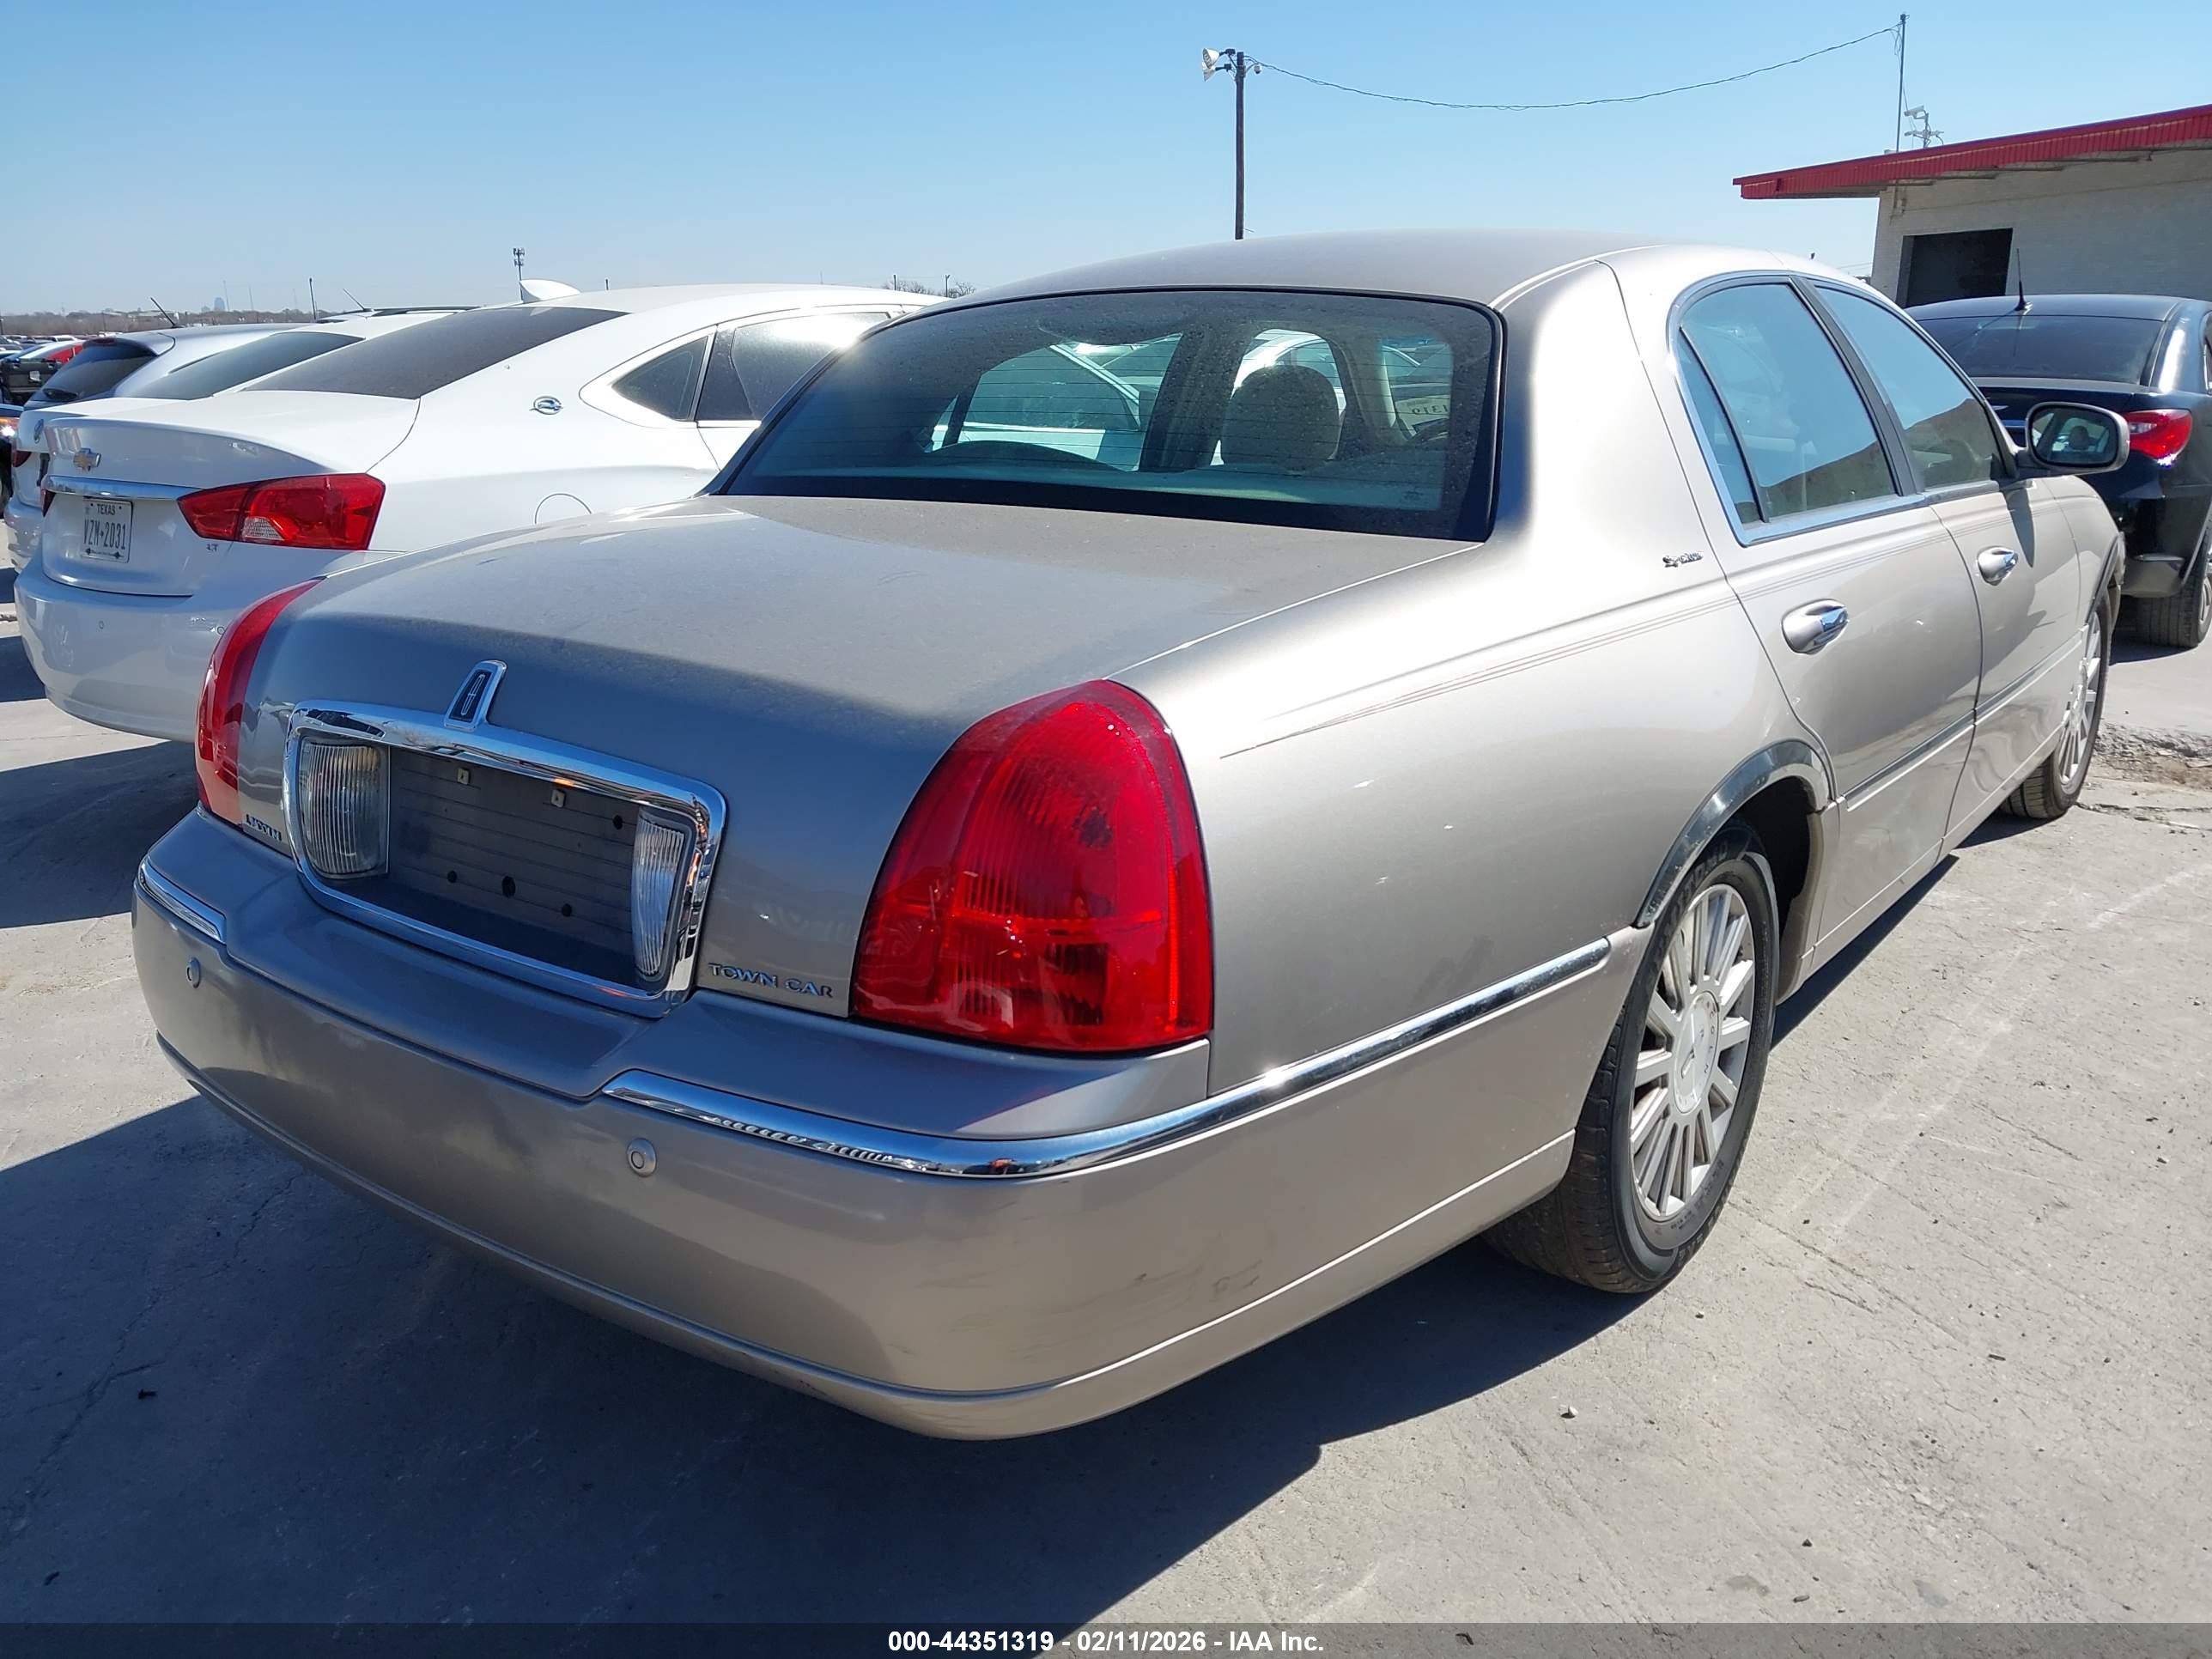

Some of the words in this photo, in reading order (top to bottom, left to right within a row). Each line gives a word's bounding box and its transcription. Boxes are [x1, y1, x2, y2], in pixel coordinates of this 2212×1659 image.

[96, 503, 116, 516] TEXAS
[708, 962, 779, 988] TOWN
[785, 977, 834, 999] CAR
